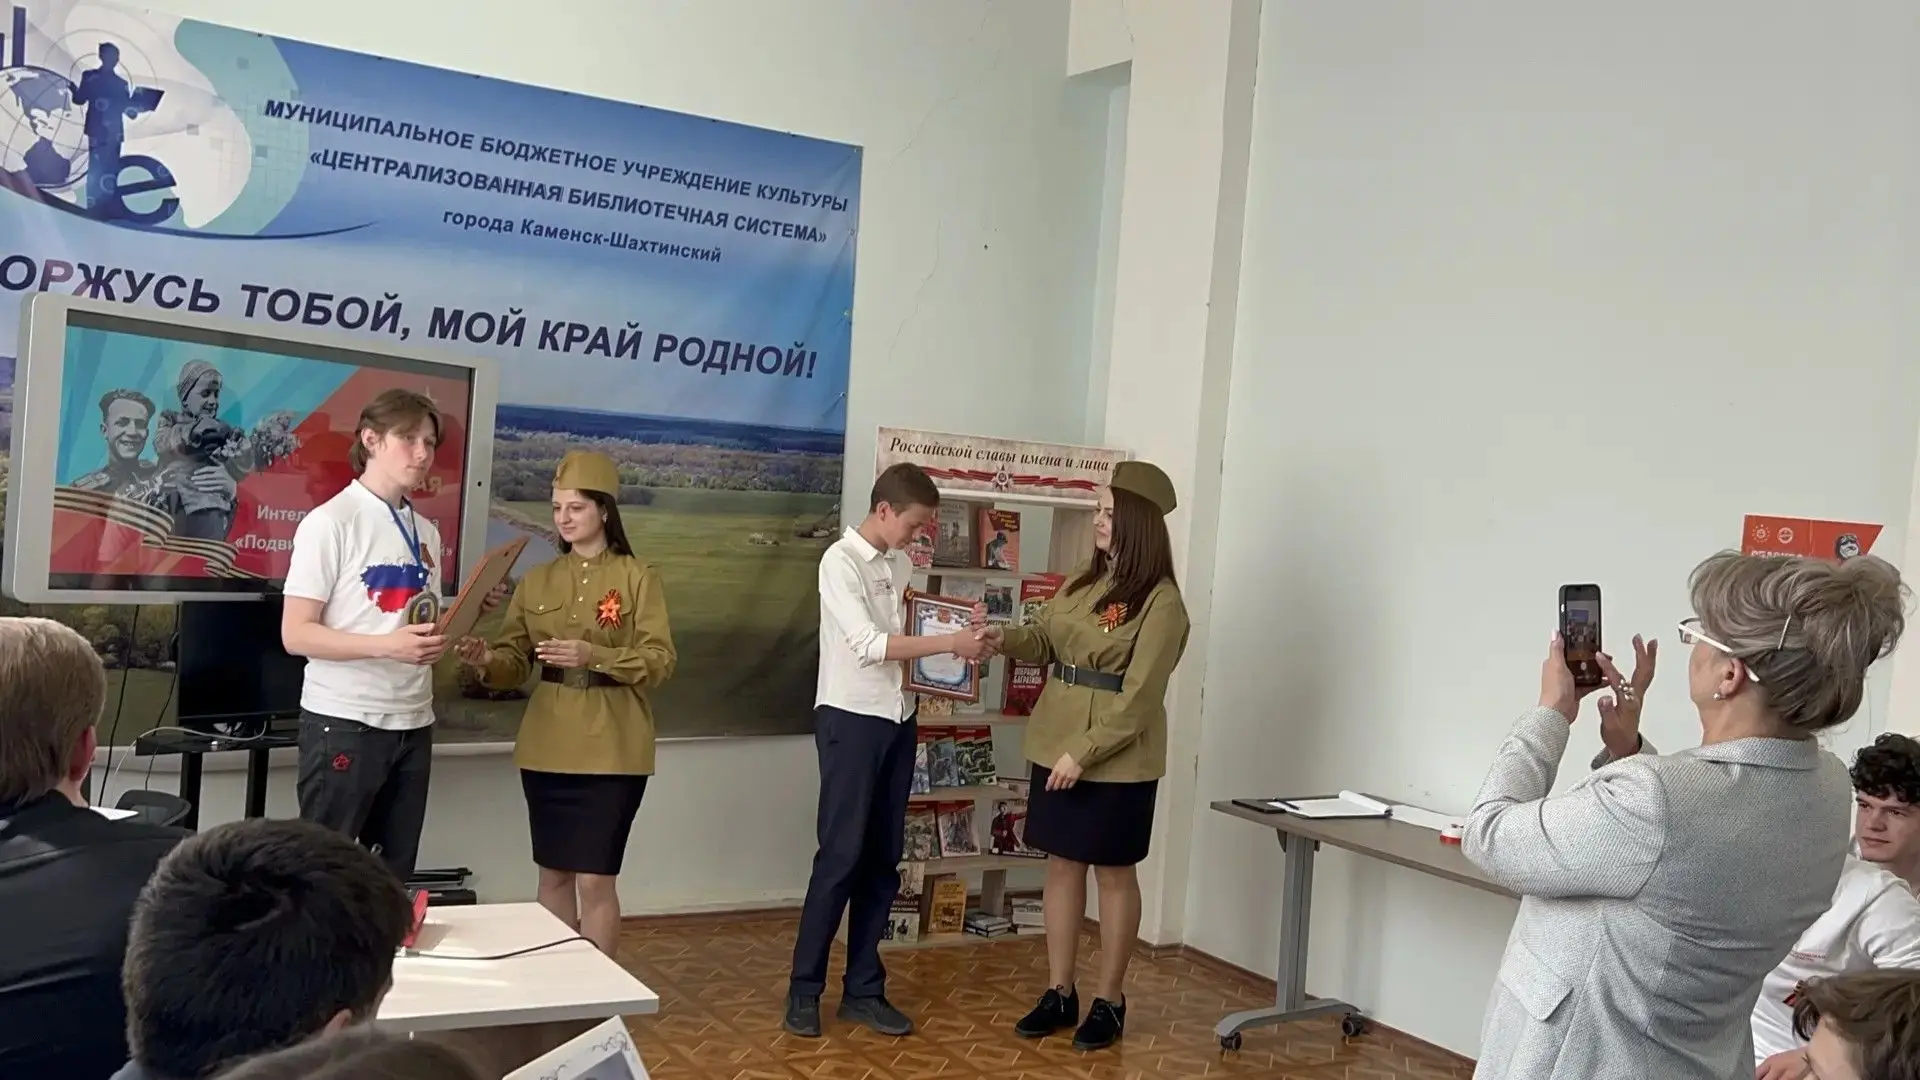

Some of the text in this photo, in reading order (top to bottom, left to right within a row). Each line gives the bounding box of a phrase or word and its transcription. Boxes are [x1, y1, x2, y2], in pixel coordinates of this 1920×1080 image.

[265, 99, 848, 213] МУНИЦИПАЛЬНОЕ БЮДЖЕТНОЕ УЧРЕЖДЕНИЕ КУЛЬТУРЫ
[310, 148, 827, 244] «ЦЕНТРАЛИЗОВАННАЯ БИБЛИОТЕЧНАЯ СИСТЕМА»
[443, 209, 722, 264] города Каменск-Шахтинский
[0, 254, 818, 380] ОРЖУСЬ ТОБОЙ, МОЙ КРАЙ РОДНОЙ!
[889, 436, 1110, 472] Российской славы имена и лица
[257, 505, 306, 522] Интел
[235, 534, 294, 551] «Подви
